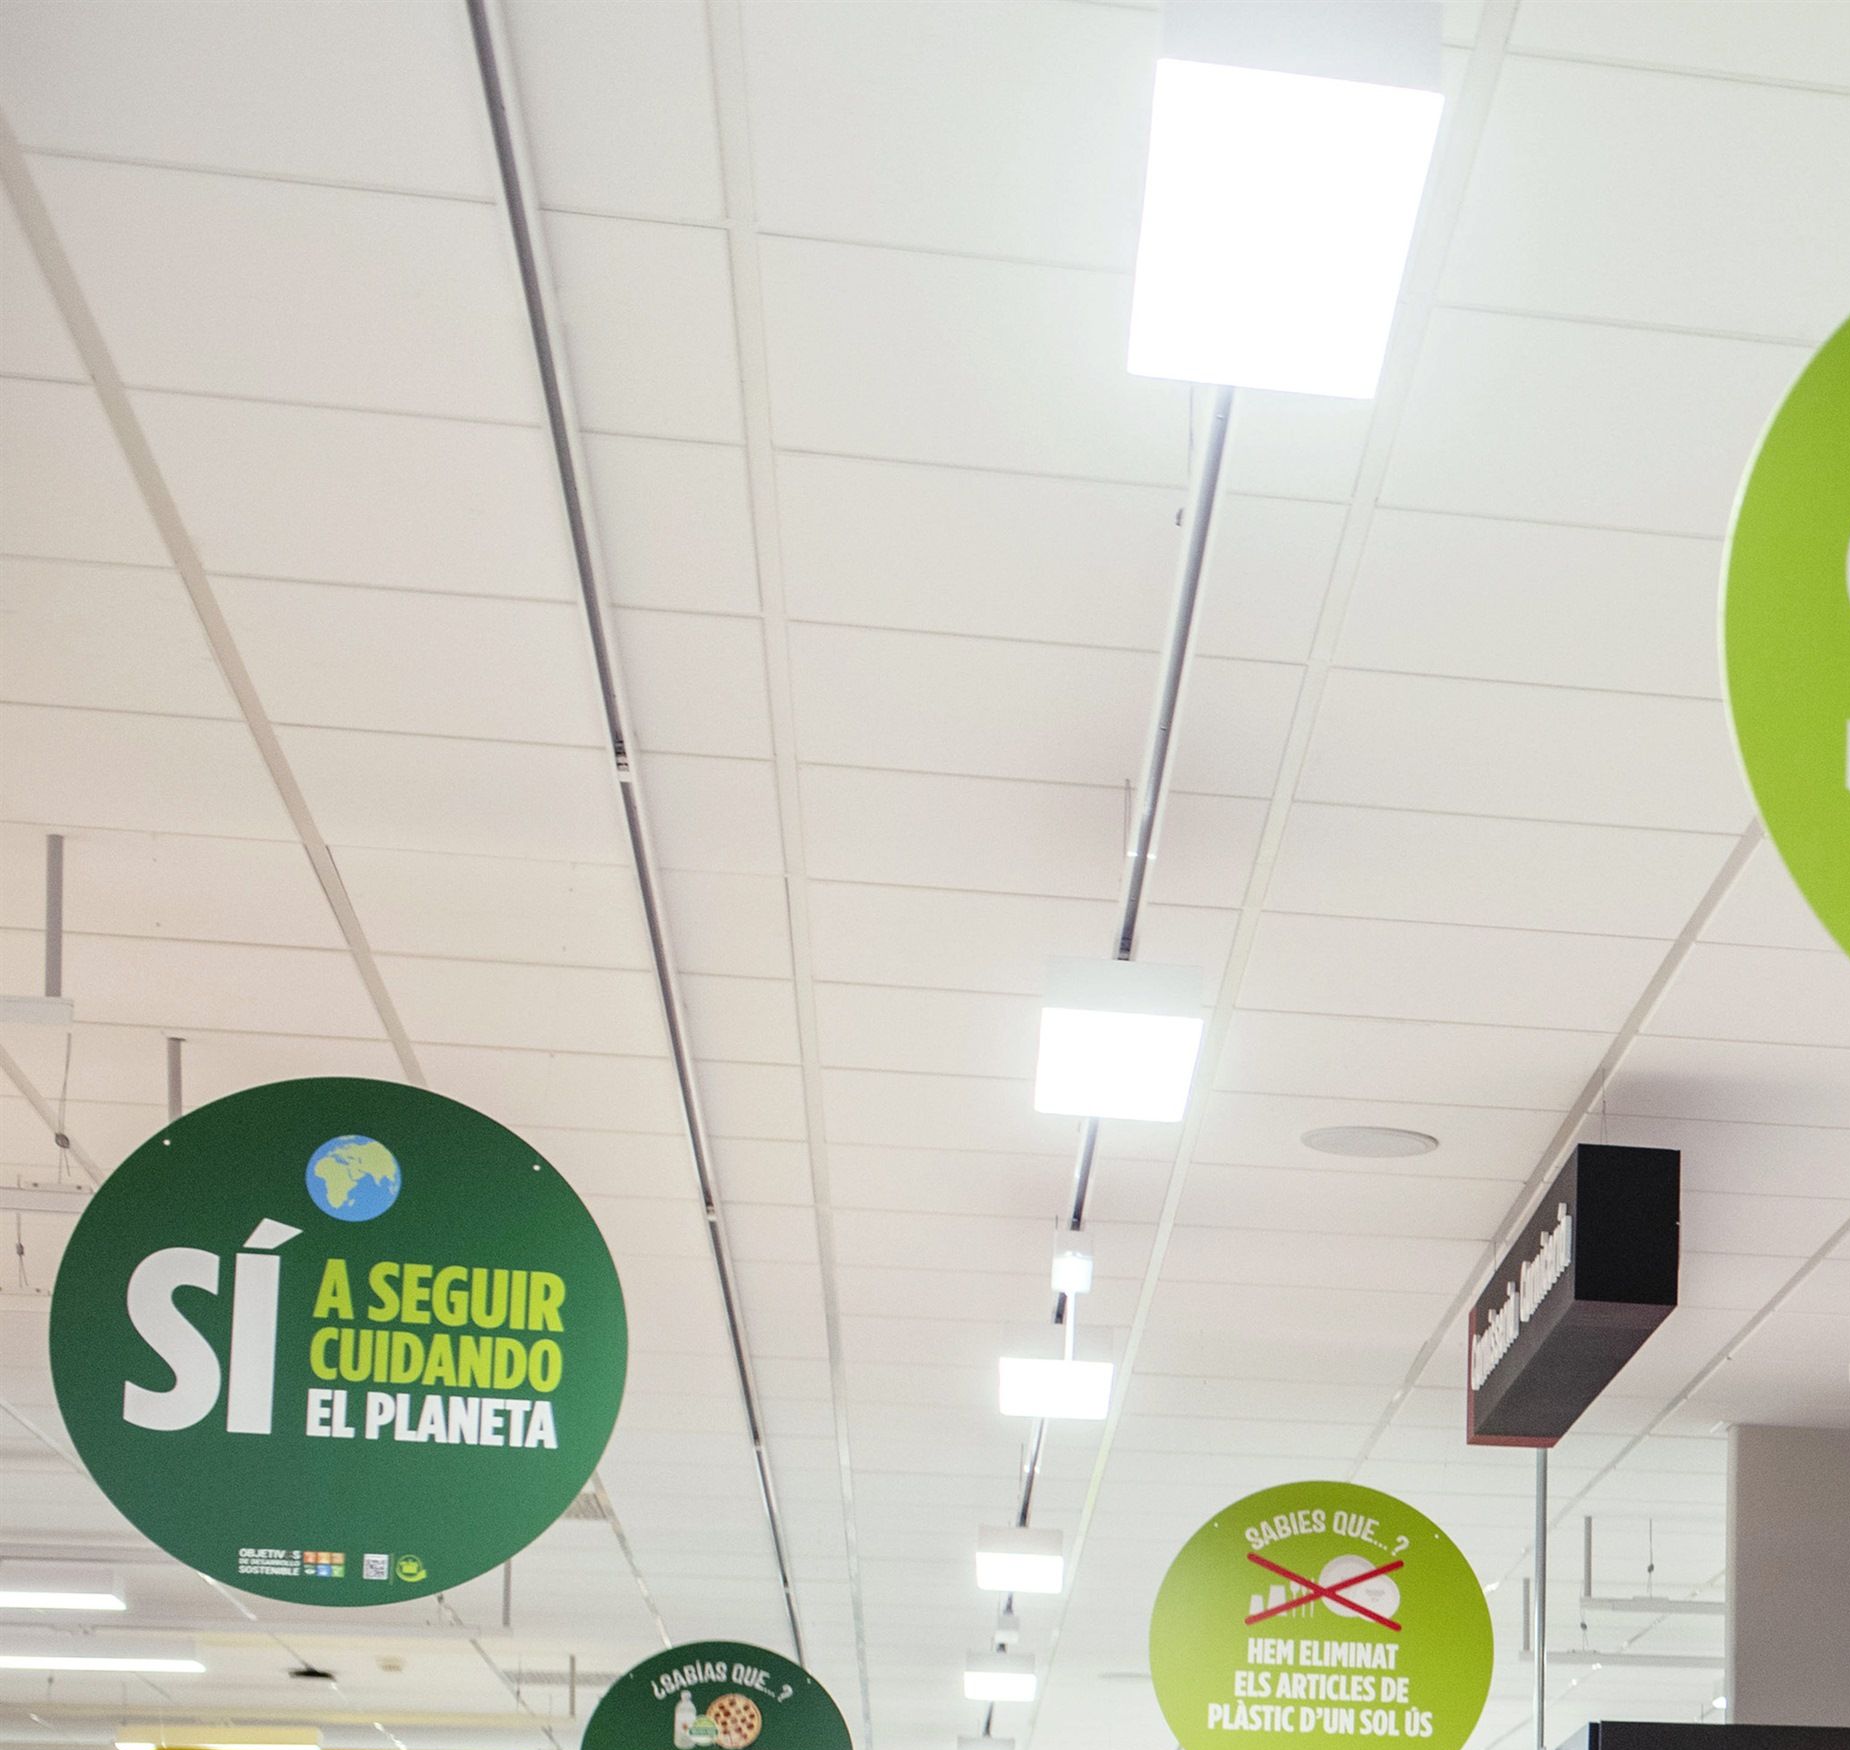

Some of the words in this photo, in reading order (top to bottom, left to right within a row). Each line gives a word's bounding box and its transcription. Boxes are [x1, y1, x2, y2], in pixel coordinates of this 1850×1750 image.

[312, 1257, 354, 1320] A
[367, 1261, 567, 1332] SEGUIR
[123, 1218, 303, 1434] SÍ
[308, 1326, 563, 1394] CUIDANDO
[306, 1387, 355, 1438] EL
[364, 1391, 558, 1449] PLANETA
[1244, 1508, 1326, 1550] SABIES
[1247, 1637, 1294, 1665] HEM
[1299, 1639, 1398, 1670] ELIMINAT
[1234, 1670, 1271, 1698] ELS
[1276, 1672, 1375, 1702] ARTICLES
[1380, 1676, 1409, 1703] DE
[1359, 1709, 1399, 1736] SOL
[1404, 1707, 1434, 1738] ÚS
